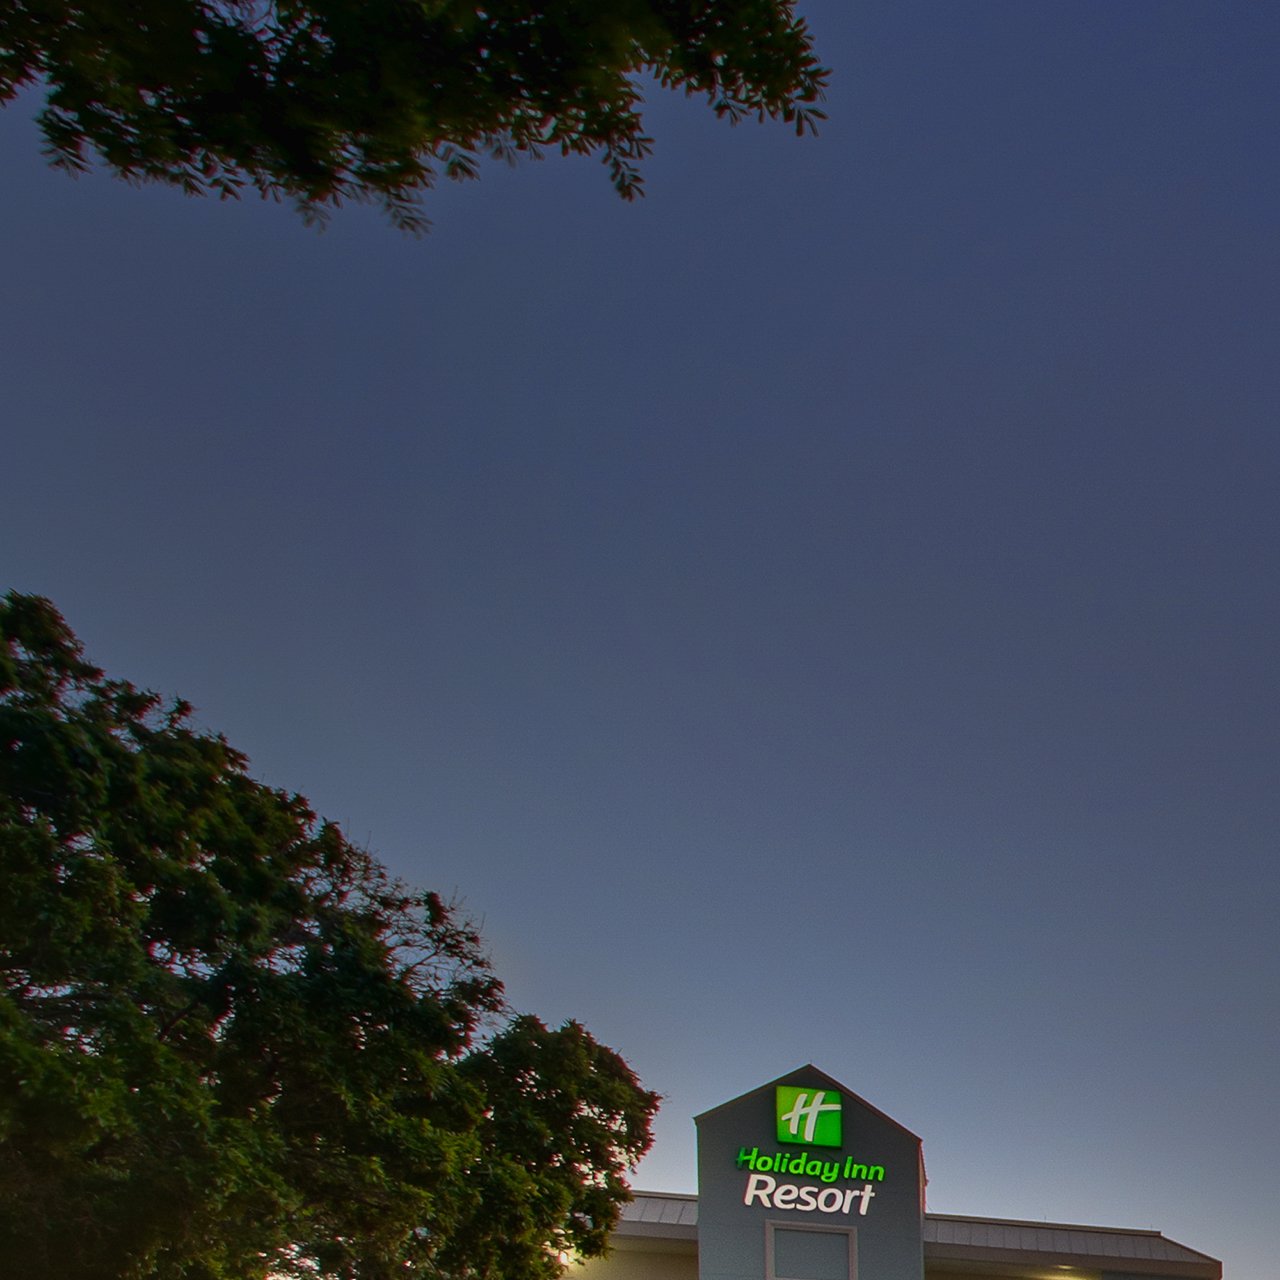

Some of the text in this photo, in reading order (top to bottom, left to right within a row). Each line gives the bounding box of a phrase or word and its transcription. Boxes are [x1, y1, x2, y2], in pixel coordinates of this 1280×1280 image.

[737, 1147, 885, 1182] Holiday Inn
[744, 1174, 876, 1216] Resort
